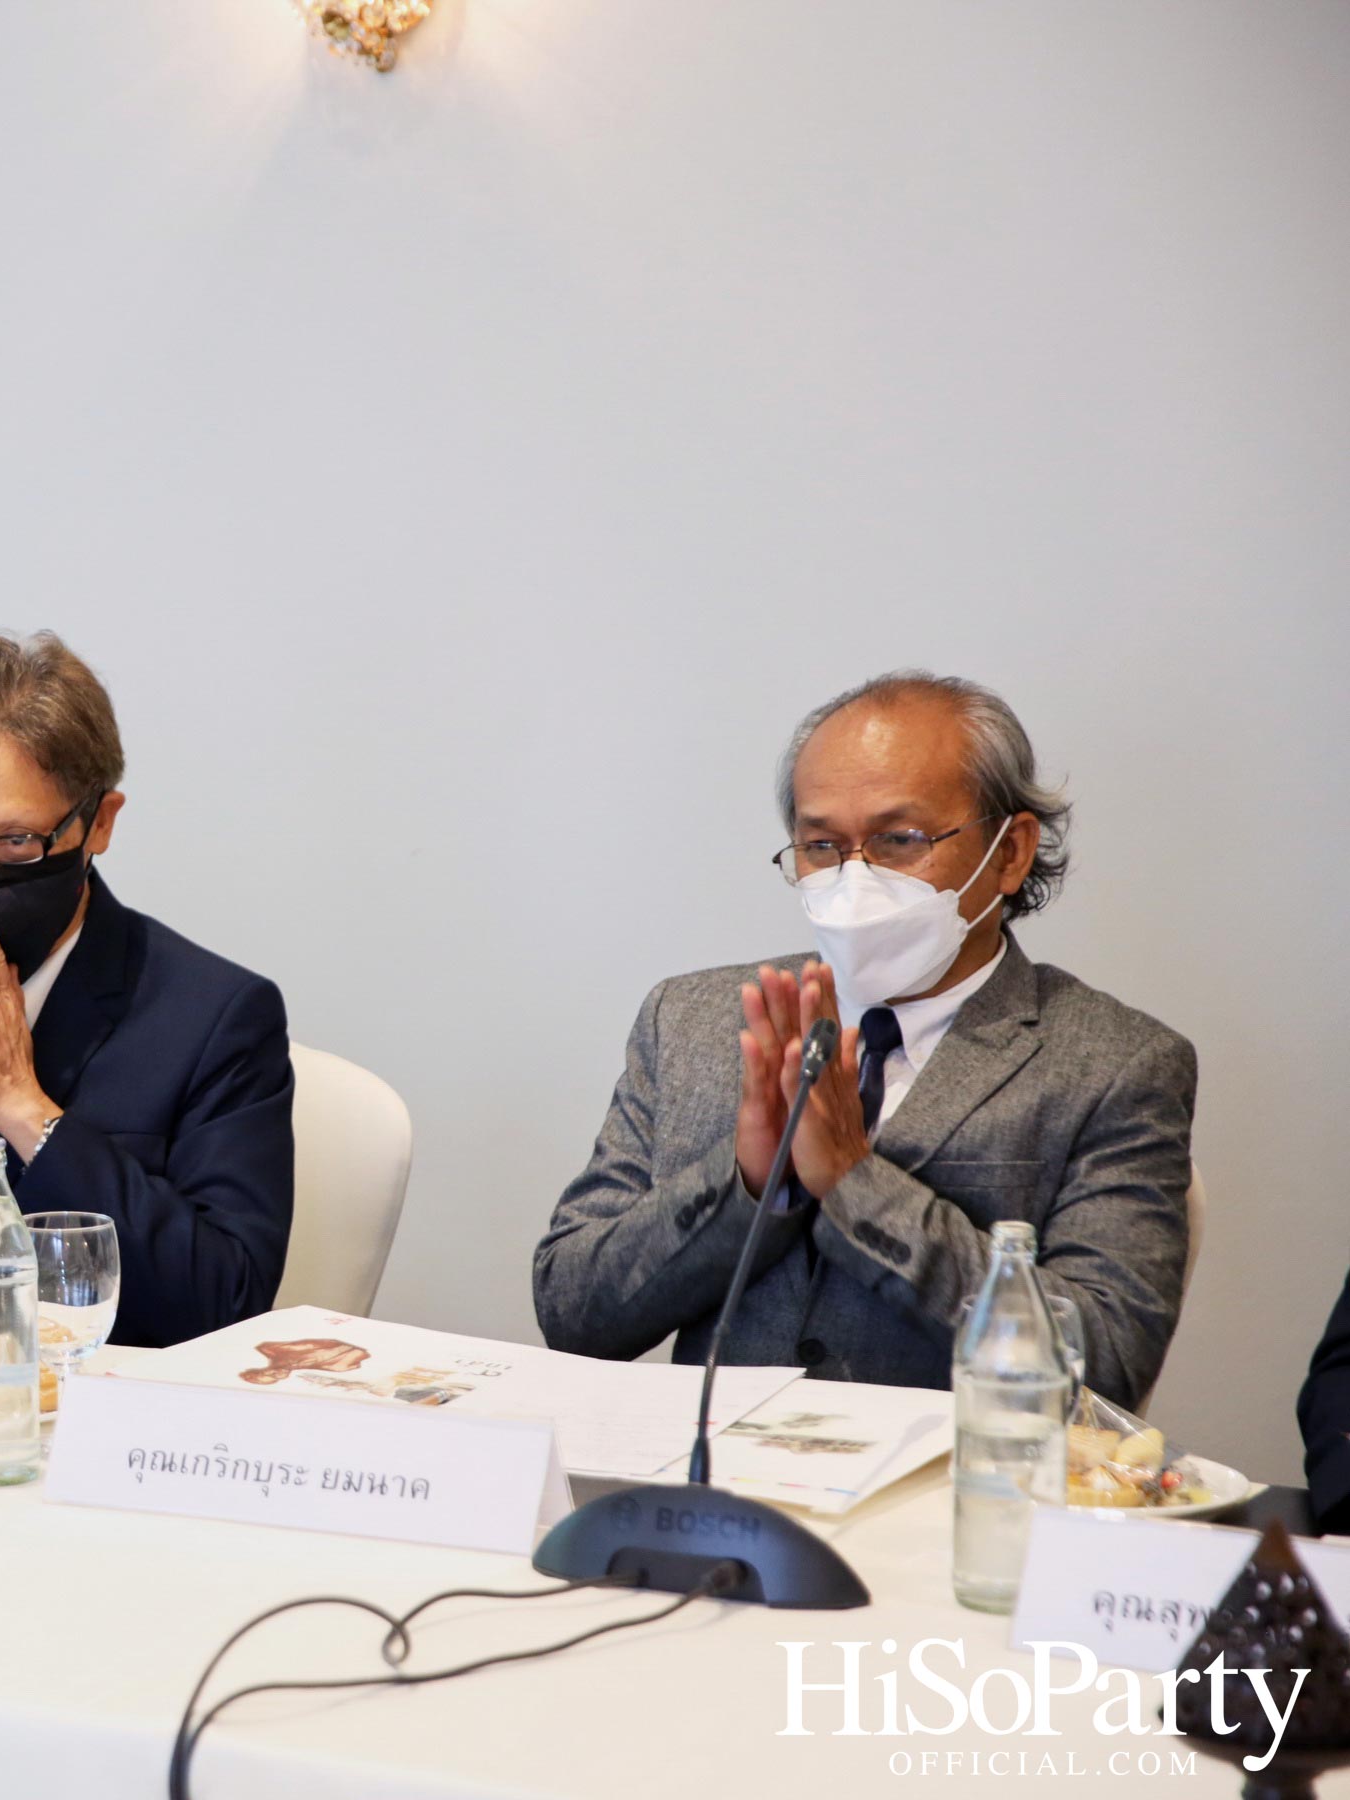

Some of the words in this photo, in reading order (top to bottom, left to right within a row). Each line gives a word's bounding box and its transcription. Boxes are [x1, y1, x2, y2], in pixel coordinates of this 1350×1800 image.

[128, 1443, 310, 1498] คุณเกริกบุระ
[320, 1467, 430, 1500] ยมนาค
[655, 1506, 762, 1541] BOSCH
